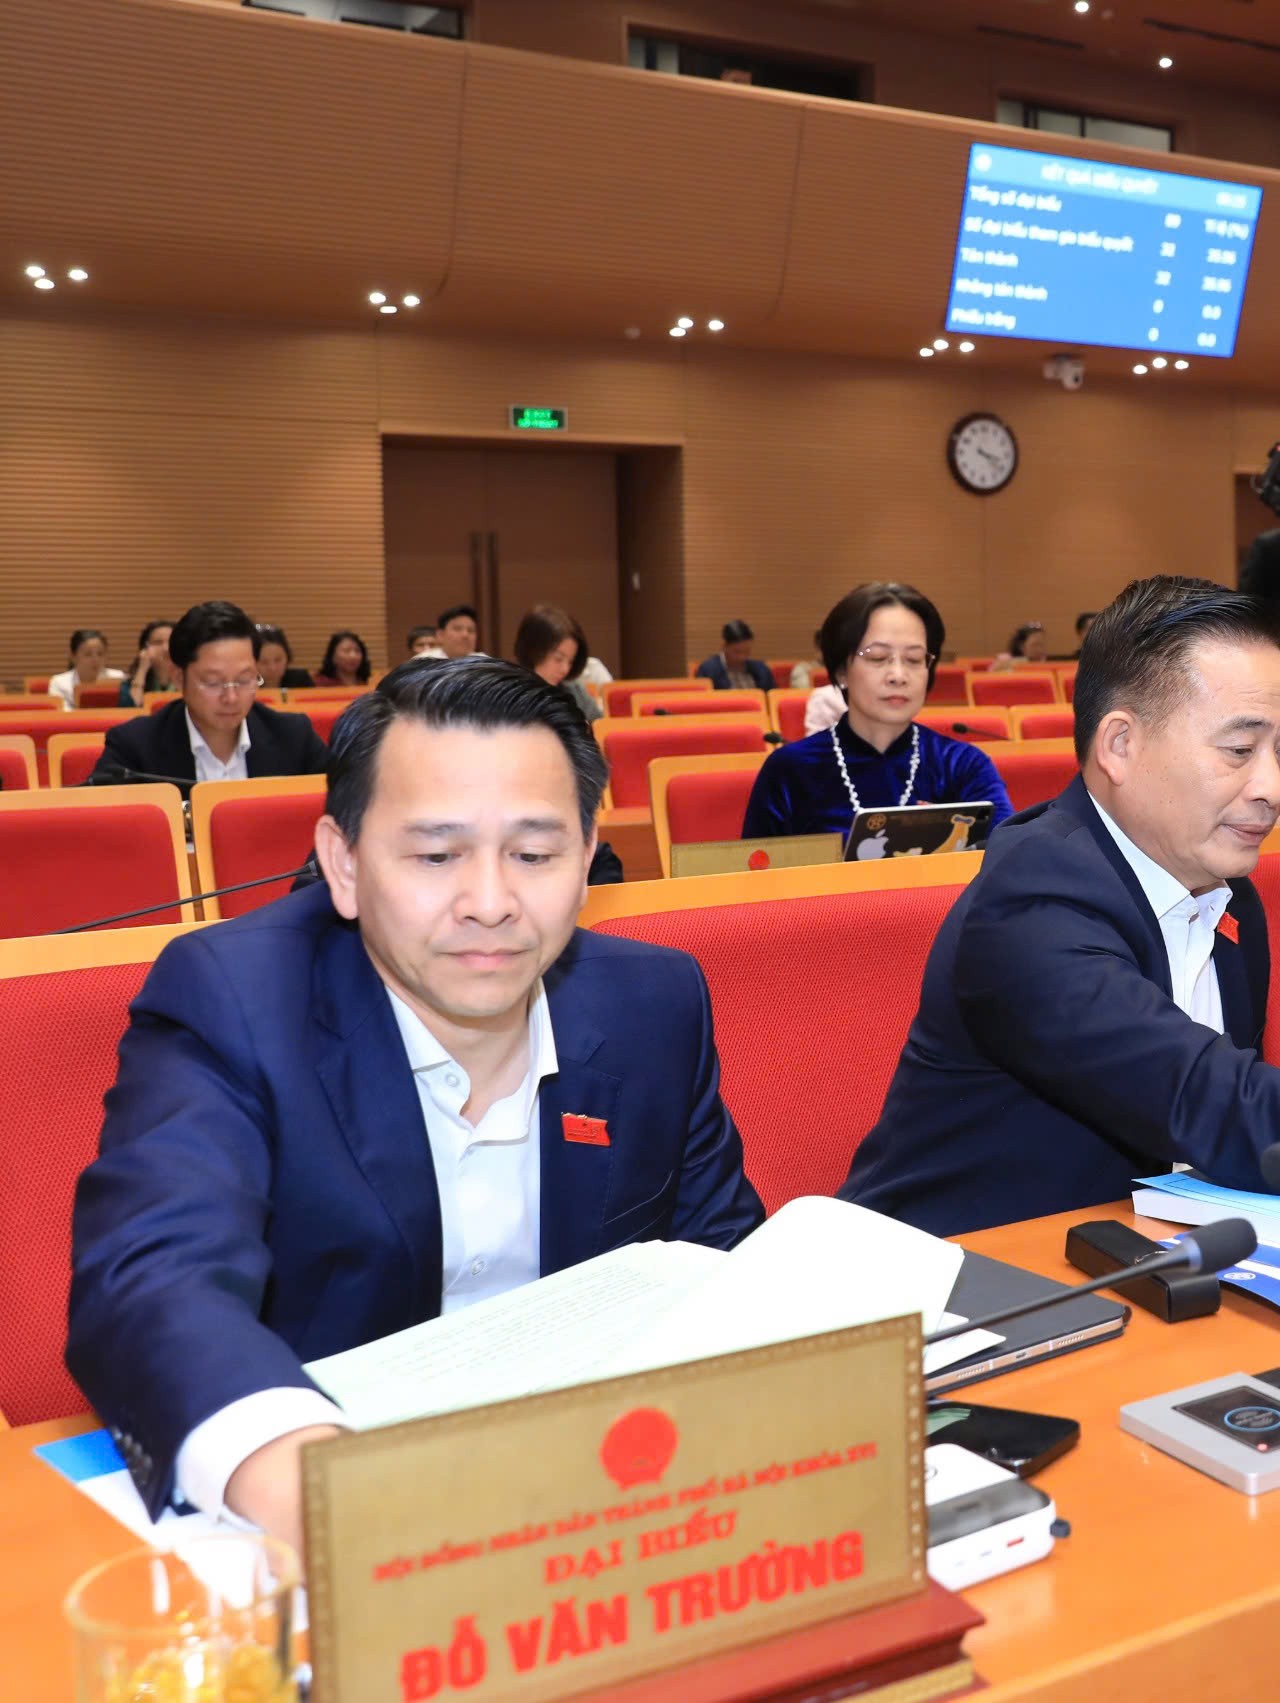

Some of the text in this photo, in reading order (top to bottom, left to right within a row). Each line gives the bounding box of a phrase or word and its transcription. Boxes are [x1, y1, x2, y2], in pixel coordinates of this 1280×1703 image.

[489, 1523, 548, 1552] NHÂN
[554, 1508, 597, 1537] DÂN
[603, 1493, 672, 1525] THÀNH
[677, 1475, 718, 1506] PHỐ
[722, 1470, 748, 1495] HÀ
[753, 1461, 787, 1488] NỘI
[543, 1506, 738, 1586] ĐẠI BIỂU
[400, 1529, 865, 1703] ĐỖ VĂN TRƯỜNG
